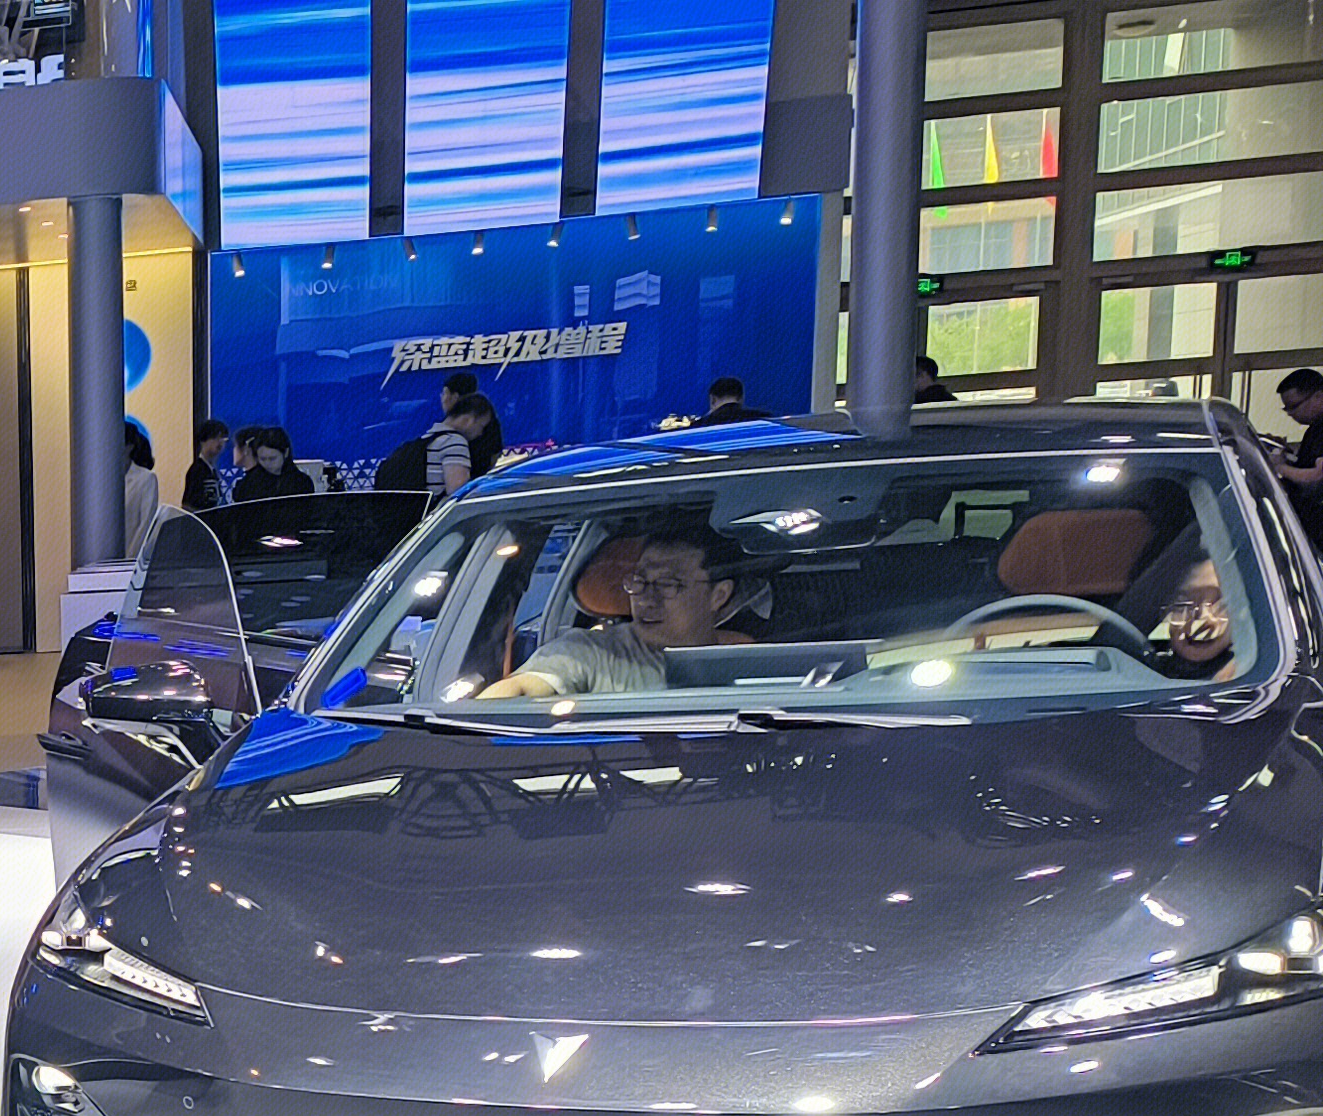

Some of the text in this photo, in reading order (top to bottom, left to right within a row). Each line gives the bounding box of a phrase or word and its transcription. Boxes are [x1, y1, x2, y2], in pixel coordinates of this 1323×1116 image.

[380, 321, 628, 390] 深蓝超级增程
